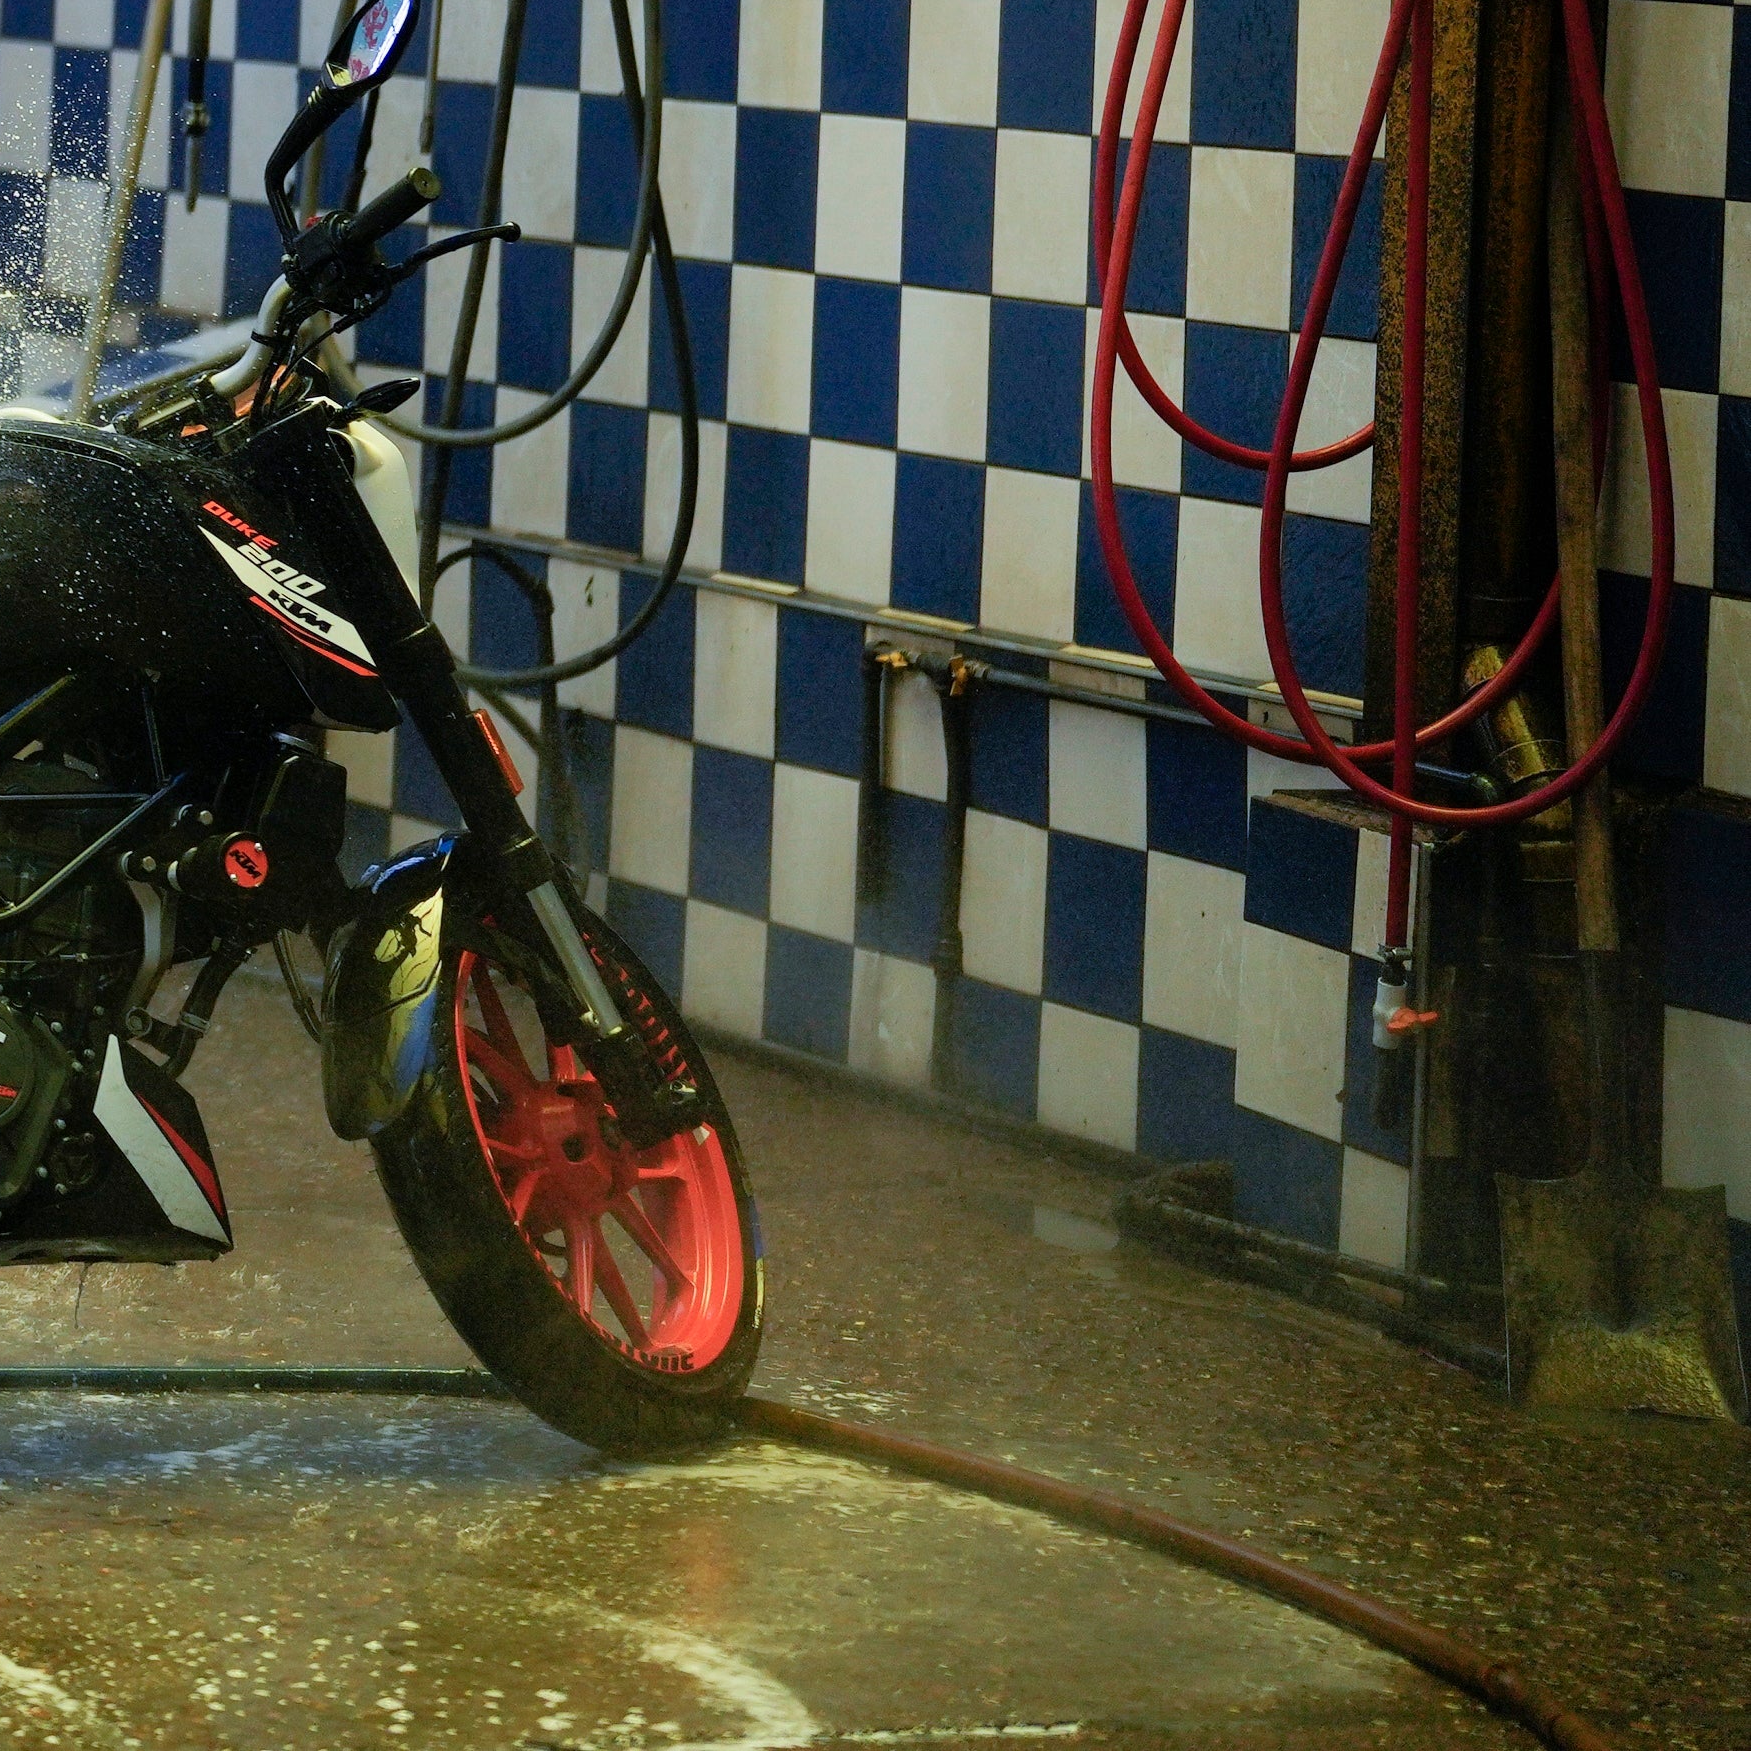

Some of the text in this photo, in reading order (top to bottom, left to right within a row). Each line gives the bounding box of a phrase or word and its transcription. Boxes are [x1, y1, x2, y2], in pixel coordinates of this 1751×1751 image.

[202, 500, 279, 551] DUKE
[236, 541, 327, 598] 200
[268, 589, 334, 634] KTM
[229, 849, 263, 880] KTM
